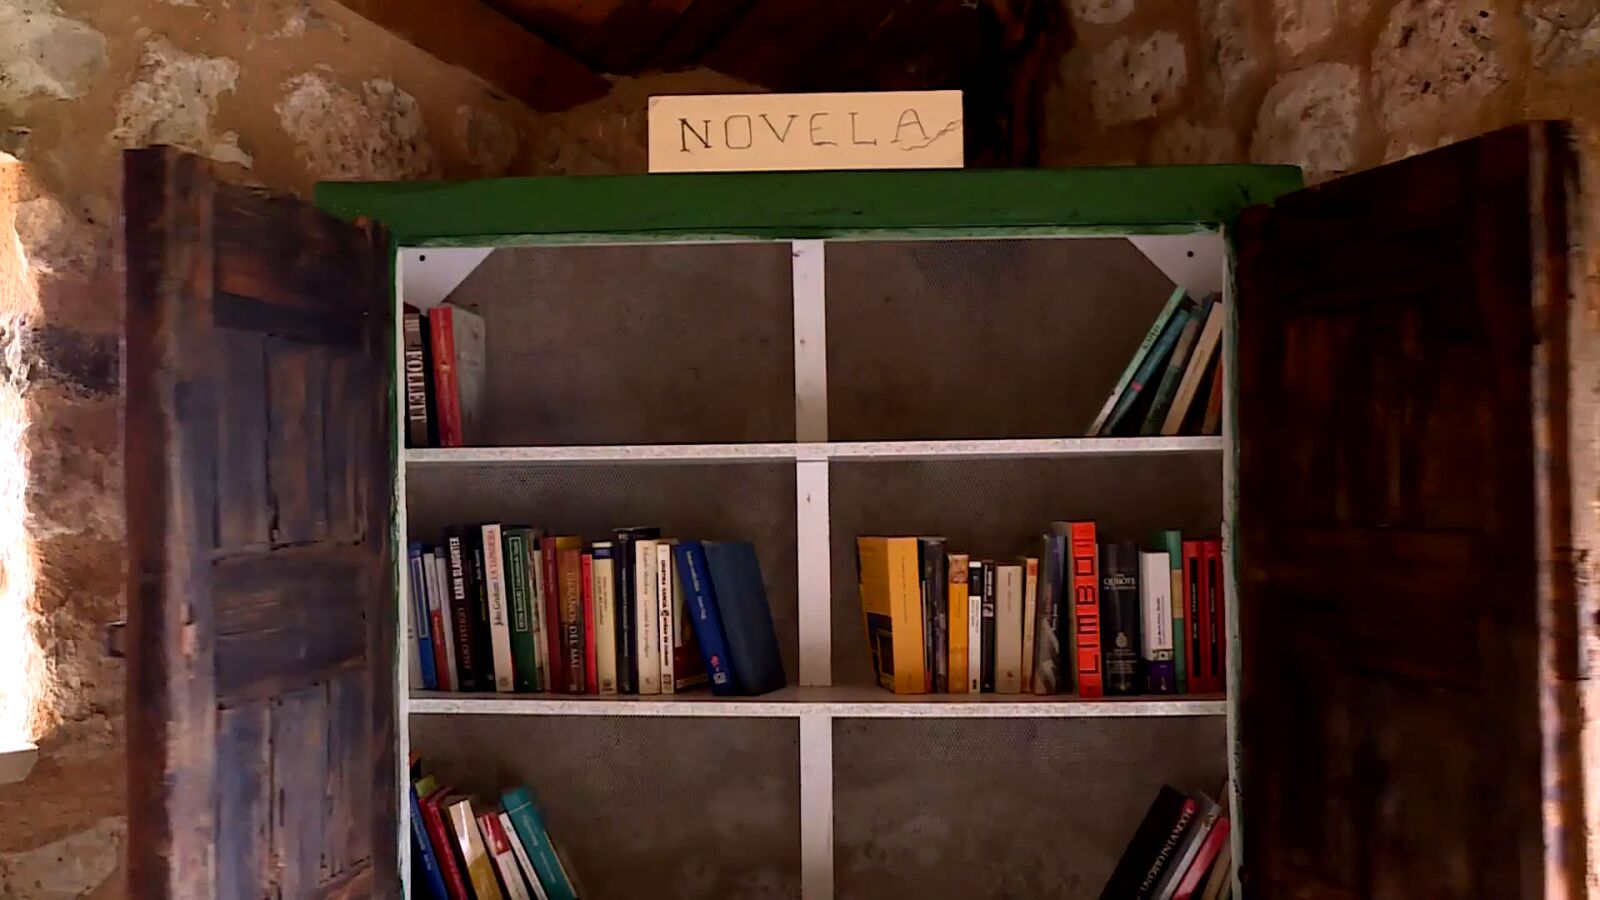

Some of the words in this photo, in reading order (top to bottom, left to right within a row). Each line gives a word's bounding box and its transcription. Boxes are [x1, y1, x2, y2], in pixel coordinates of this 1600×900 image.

[678, 107, 932, 153] NOVELA
[405, 349, 427, 423] FOLLETT
[454, 578, 465, 600] KARIN
[570, 648, 580, 669] MAL
